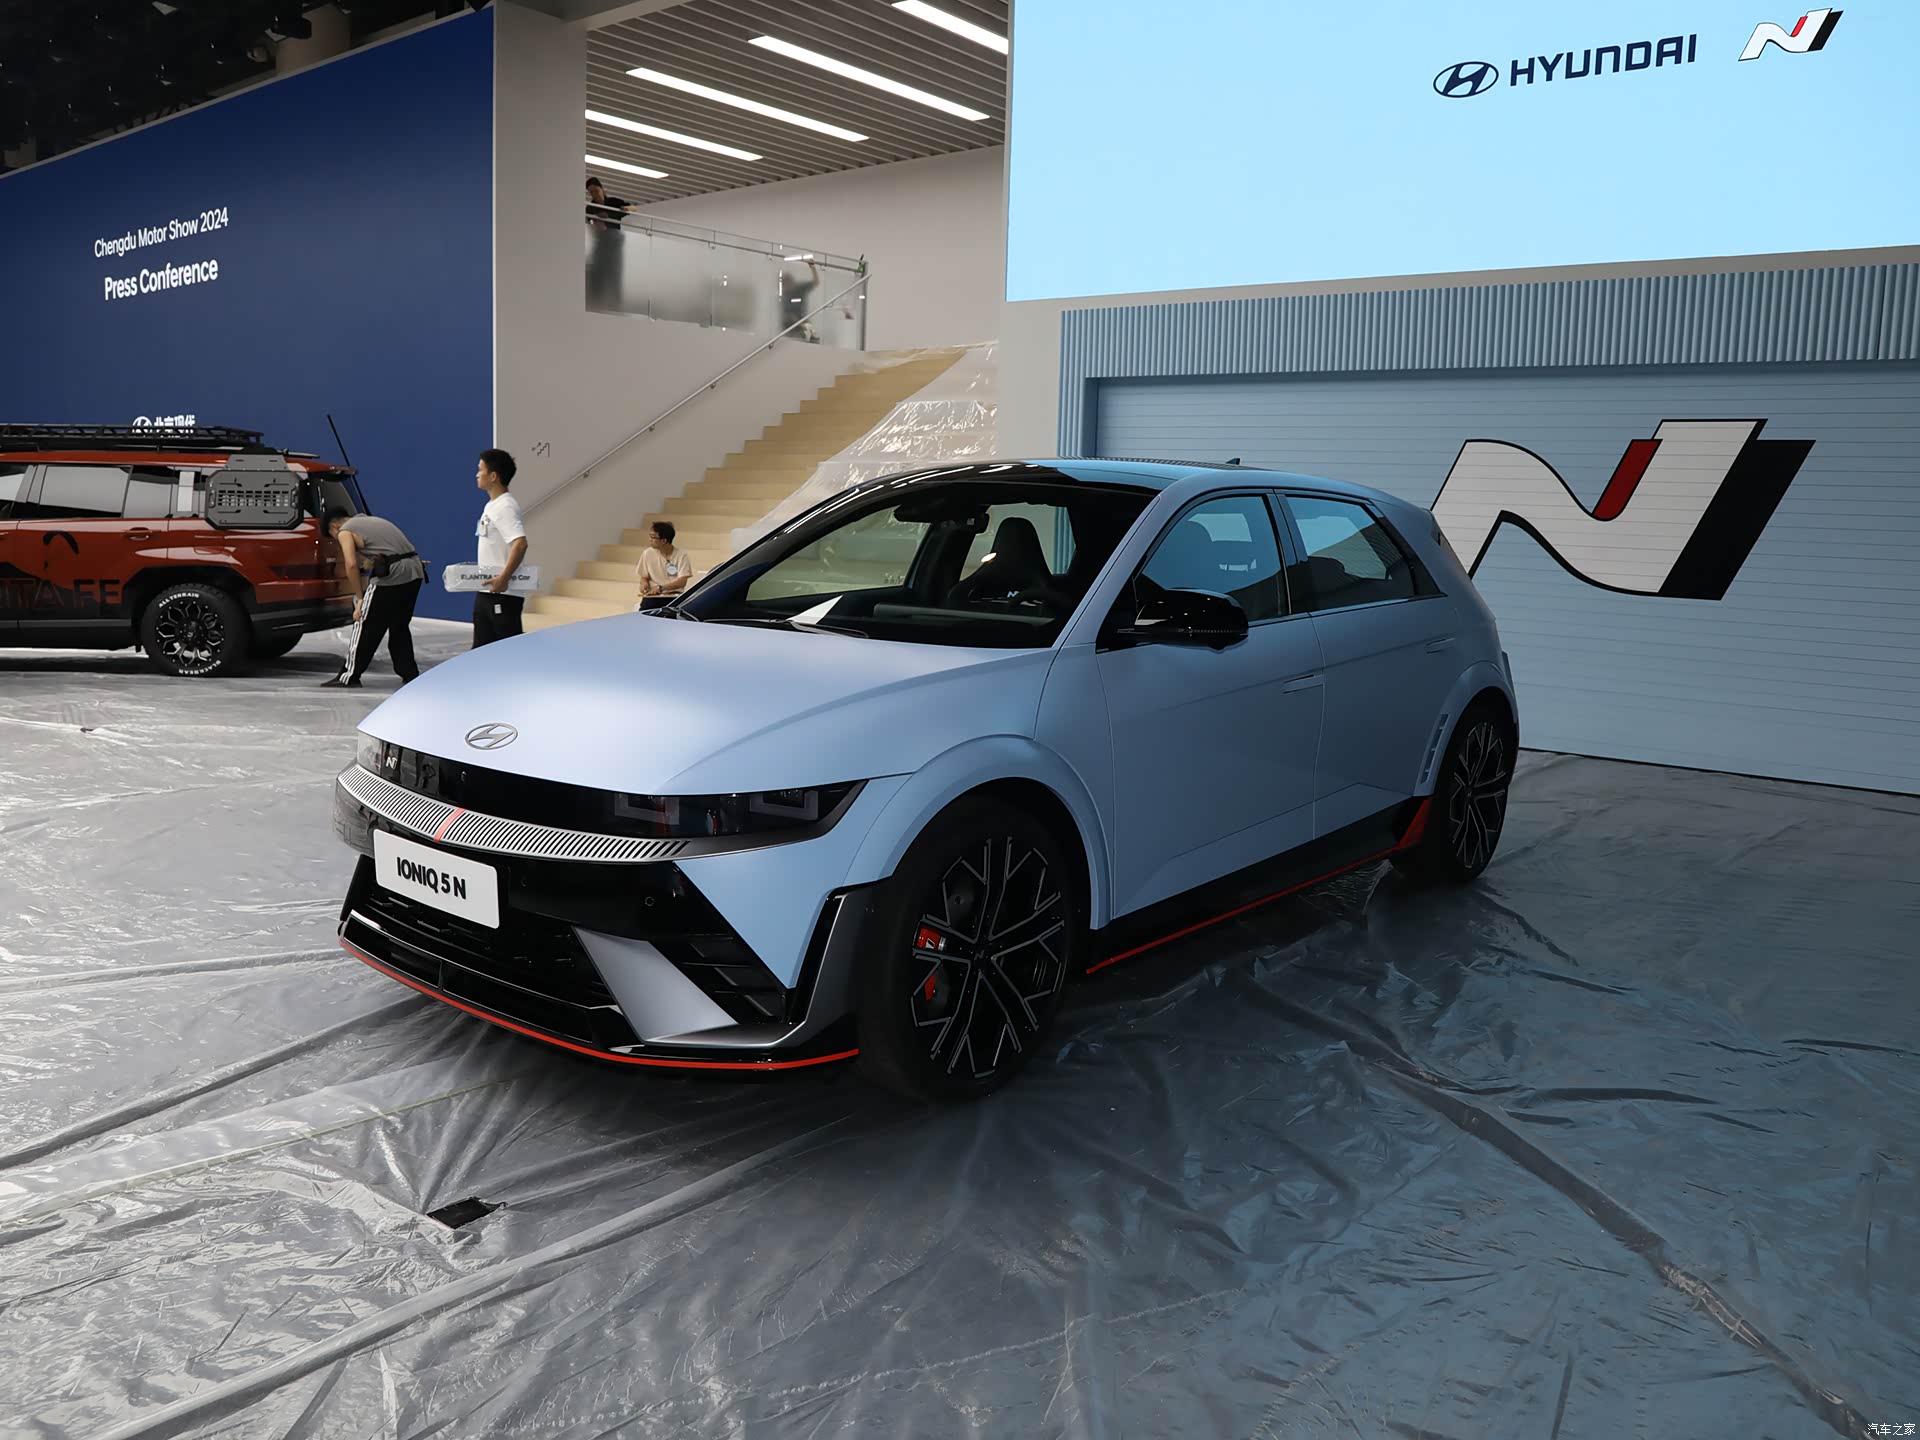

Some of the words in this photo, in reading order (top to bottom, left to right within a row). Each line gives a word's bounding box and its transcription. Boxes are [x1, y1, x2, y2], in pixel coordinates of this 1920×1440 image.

[1738, 8, 1844, 62] N
[1510, 34, 1697, 87] HYUNDAI
[94, 231, 136, 258] Chengdu
[138, 226, 168, 247] Motor
[168, 219, 199, 240] Show
[200, 206, 229, 232] 2024
[104, 276, 138, 301] Press
[139, 259, 219, 294] Conference
[159, 598, 170, 608] ALL
[169, 593, 199, 602] TERRAIN
[179, 660, 221, 675] BLACKBEAR
[396, 856, 439, 893] IONIQ
[441, 872, 451, 894] 5
[453, 876, 467, 900] N
